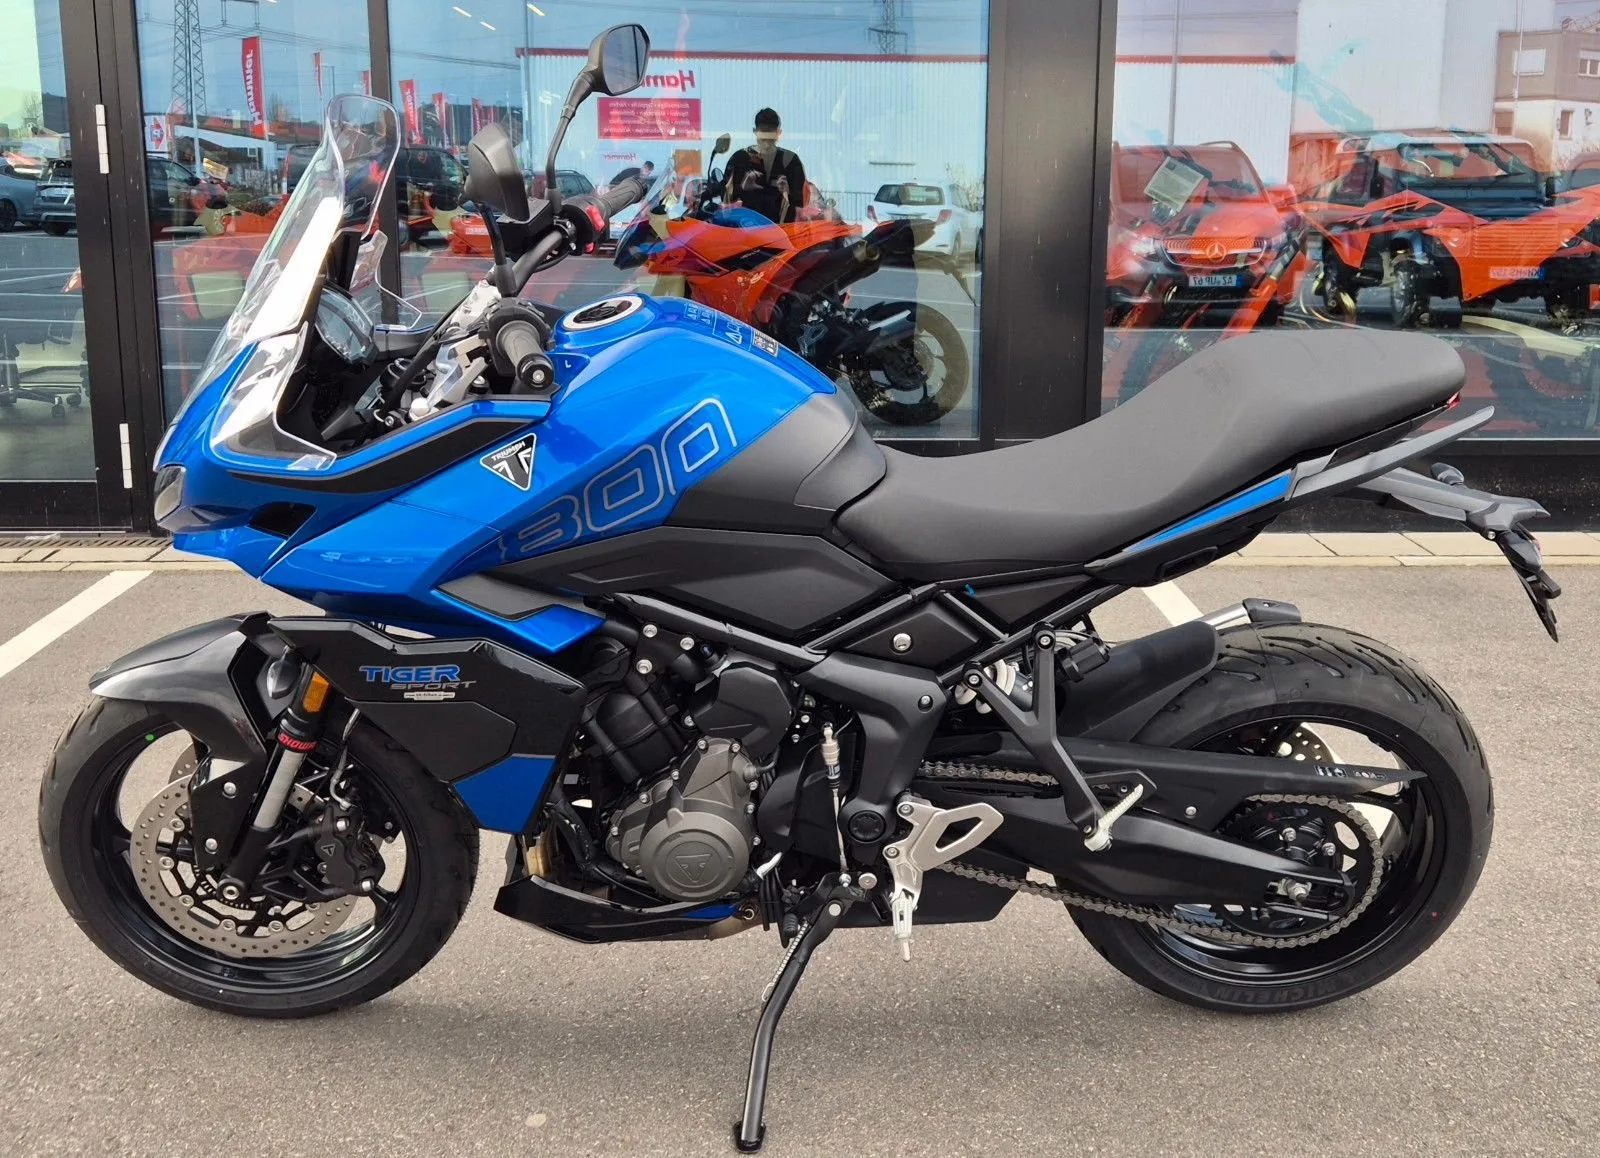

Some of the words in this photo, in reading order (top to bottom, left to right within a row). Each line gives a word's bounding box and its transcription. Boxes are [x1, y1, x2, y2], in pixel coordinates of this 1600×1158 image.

[491, 440, 526, 462] TRIUMPH
[359, 664, 461, 682] TIGER
[390, 680, 477, 690] SPORT
[1214, 980, 1337, 1004] MICHELIN
